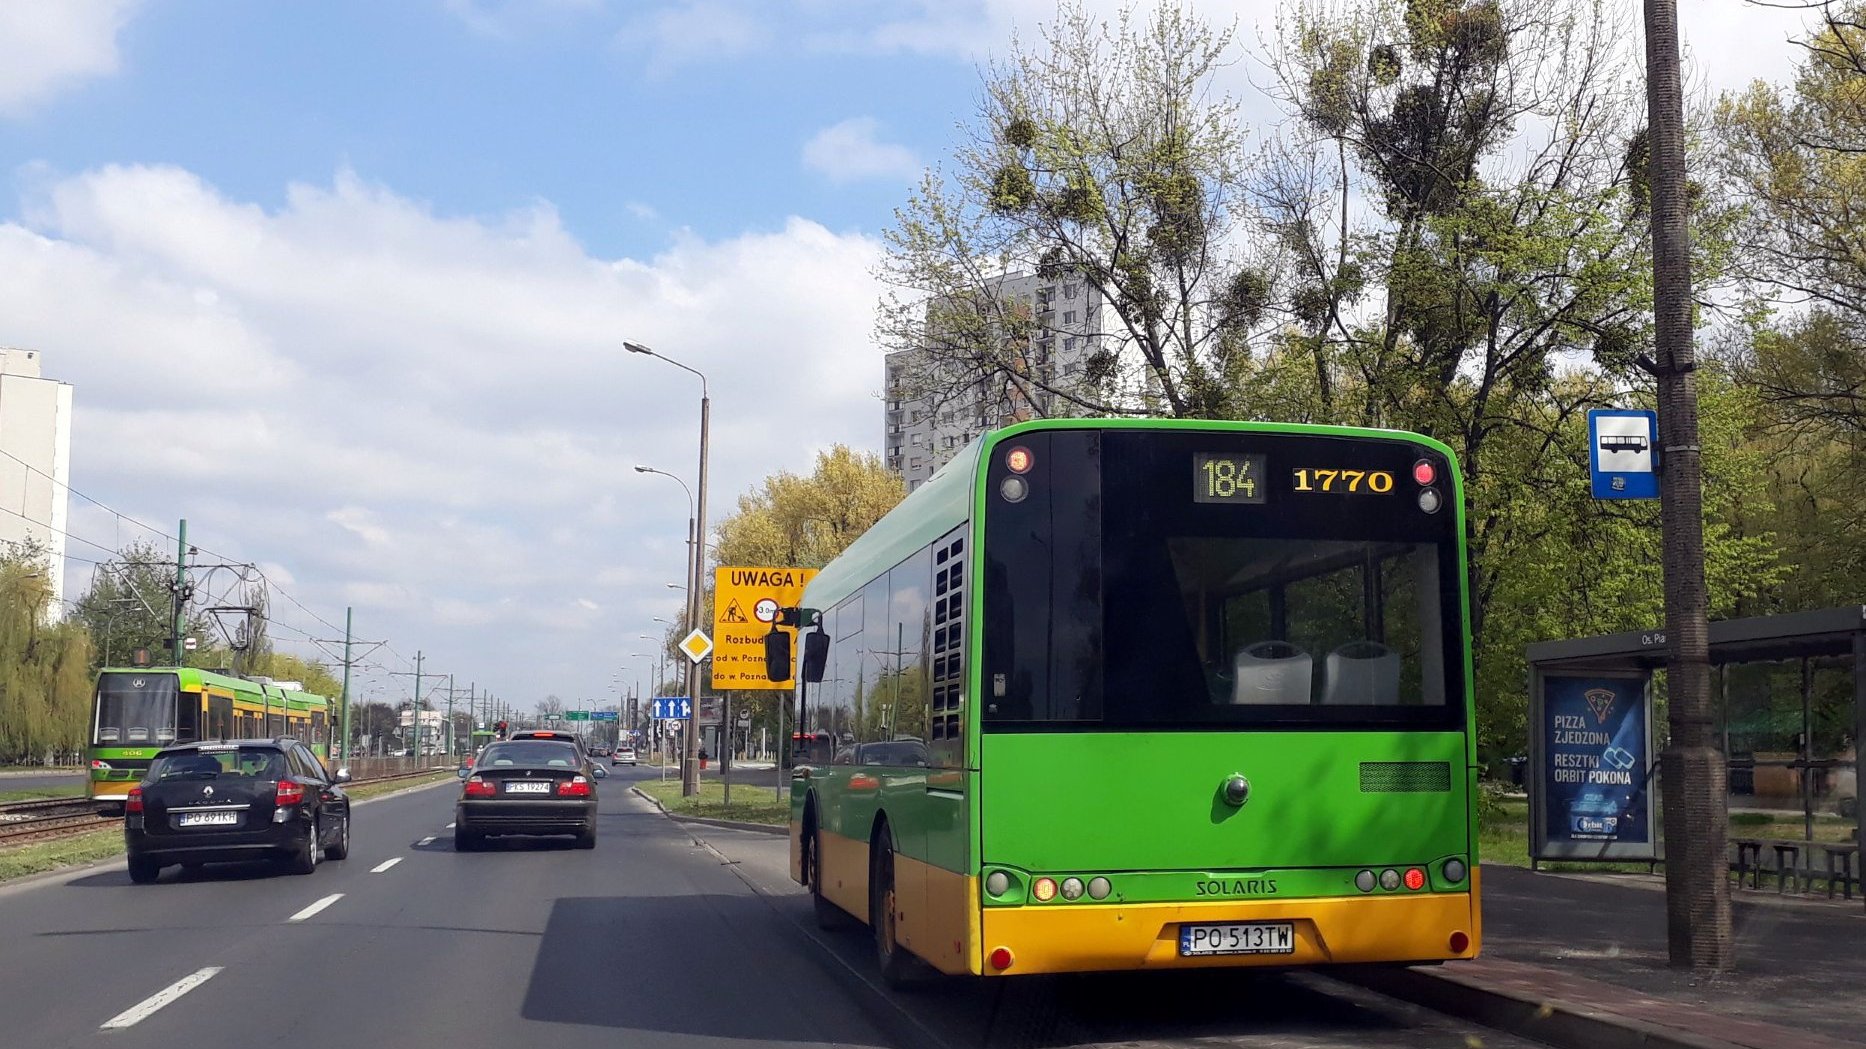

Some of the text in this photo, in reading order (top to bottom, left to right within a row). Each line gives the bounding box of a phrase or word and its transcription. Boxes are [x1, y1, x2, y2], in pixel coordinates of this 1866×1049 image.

[1202, 458, 1255, 498] 184
[1293, 469, 1394, 494] 1770
[731, 571, 794, 587] UWAGA
[726, 634, 766, 645] Rozbud
[1641, 632, 1666, 645] Os. Pia
[715, 654, 728, 663] od
[742, 654, 768, 663] Pozn
[713, 672, 725, 680] do
[740, 672, 768, 680] Pozna
[1554, 715, 1586, 729] PIZZA
[1554, 731, 1611, 745] ZJEDZONA
[1554, 753, 1600, 769] RESZTKI
[1554, 769, 1632, 785] ORBIT POKONA
[185, 812, 235, 823] PO 691KH
[1196, 879, 1278, 896] SOLARIS
[1193, 928, 1222, 948] PO
[1229, 927, 1289, 948] 513TW
